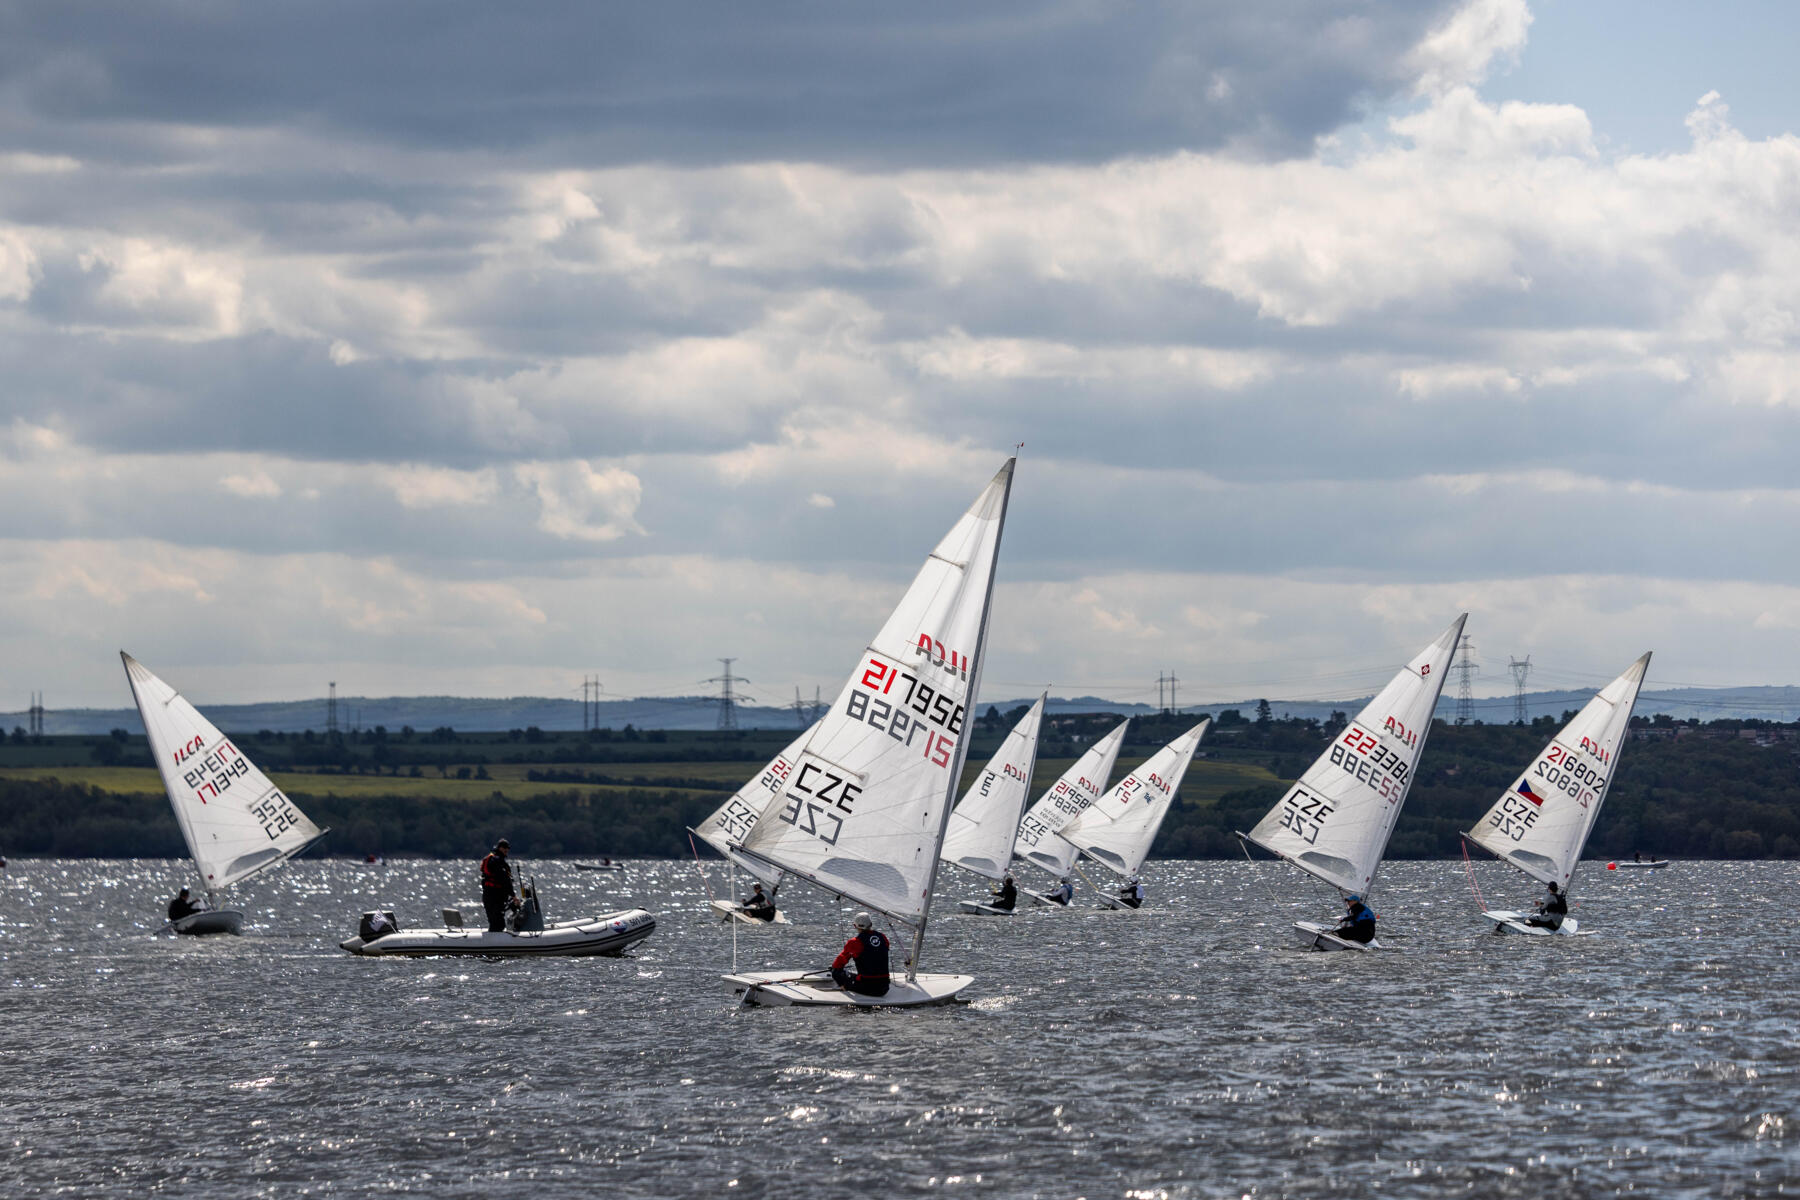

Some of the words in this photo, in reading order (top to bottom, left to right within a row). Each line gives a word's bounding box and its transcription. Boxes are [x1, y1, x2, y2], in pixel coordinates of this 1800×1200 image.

[174, 735, 205, 767] ILCA
[197, 757, 249, 805] 171349
[1547, 746, 1606, 795] 216802
[795, 762, 863, 814] CZE
[1055, 781, 1093, 809] 21958
[727, 800, 760, 829] CZE
[1287, 789, 1335, 824] CZE
[1503, 797, 1539, 829] CZE
[1023, 816, 1049, 837] CZE
